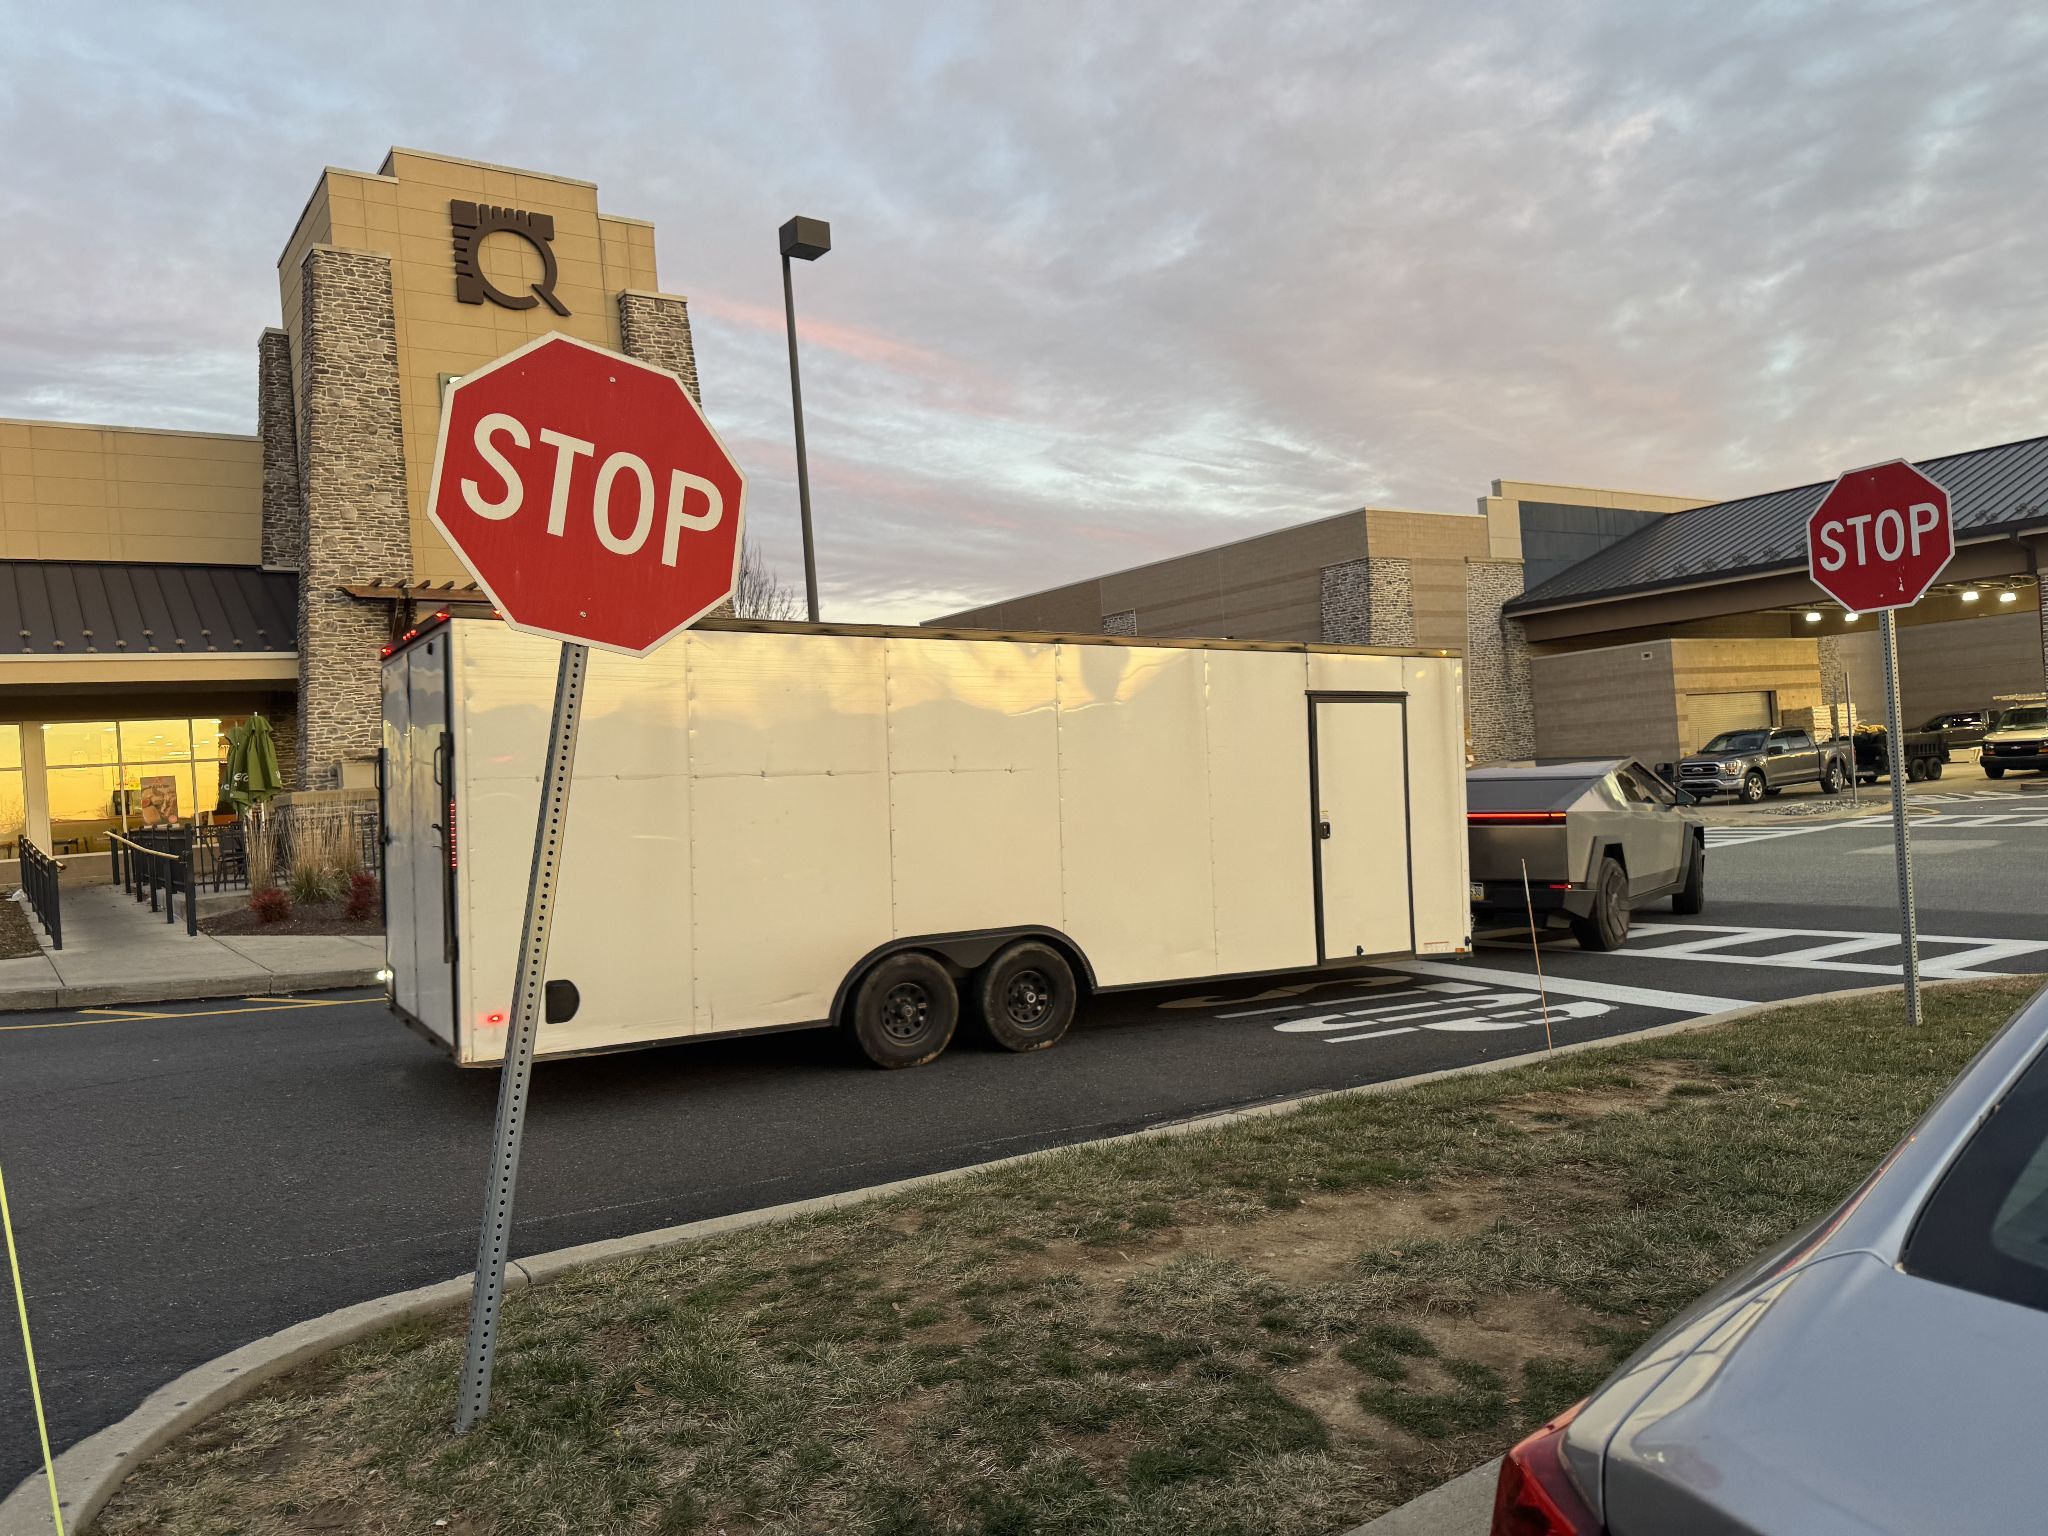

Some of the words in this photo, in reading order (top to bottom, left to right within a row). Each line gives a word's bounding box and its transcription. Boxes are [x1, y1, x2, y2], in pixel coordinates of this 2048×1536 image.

[460, 412, 723, 567] STOP
[1819, 502, 1940, 572] STOP
[1157, 976, 1616, 1043] STOP
